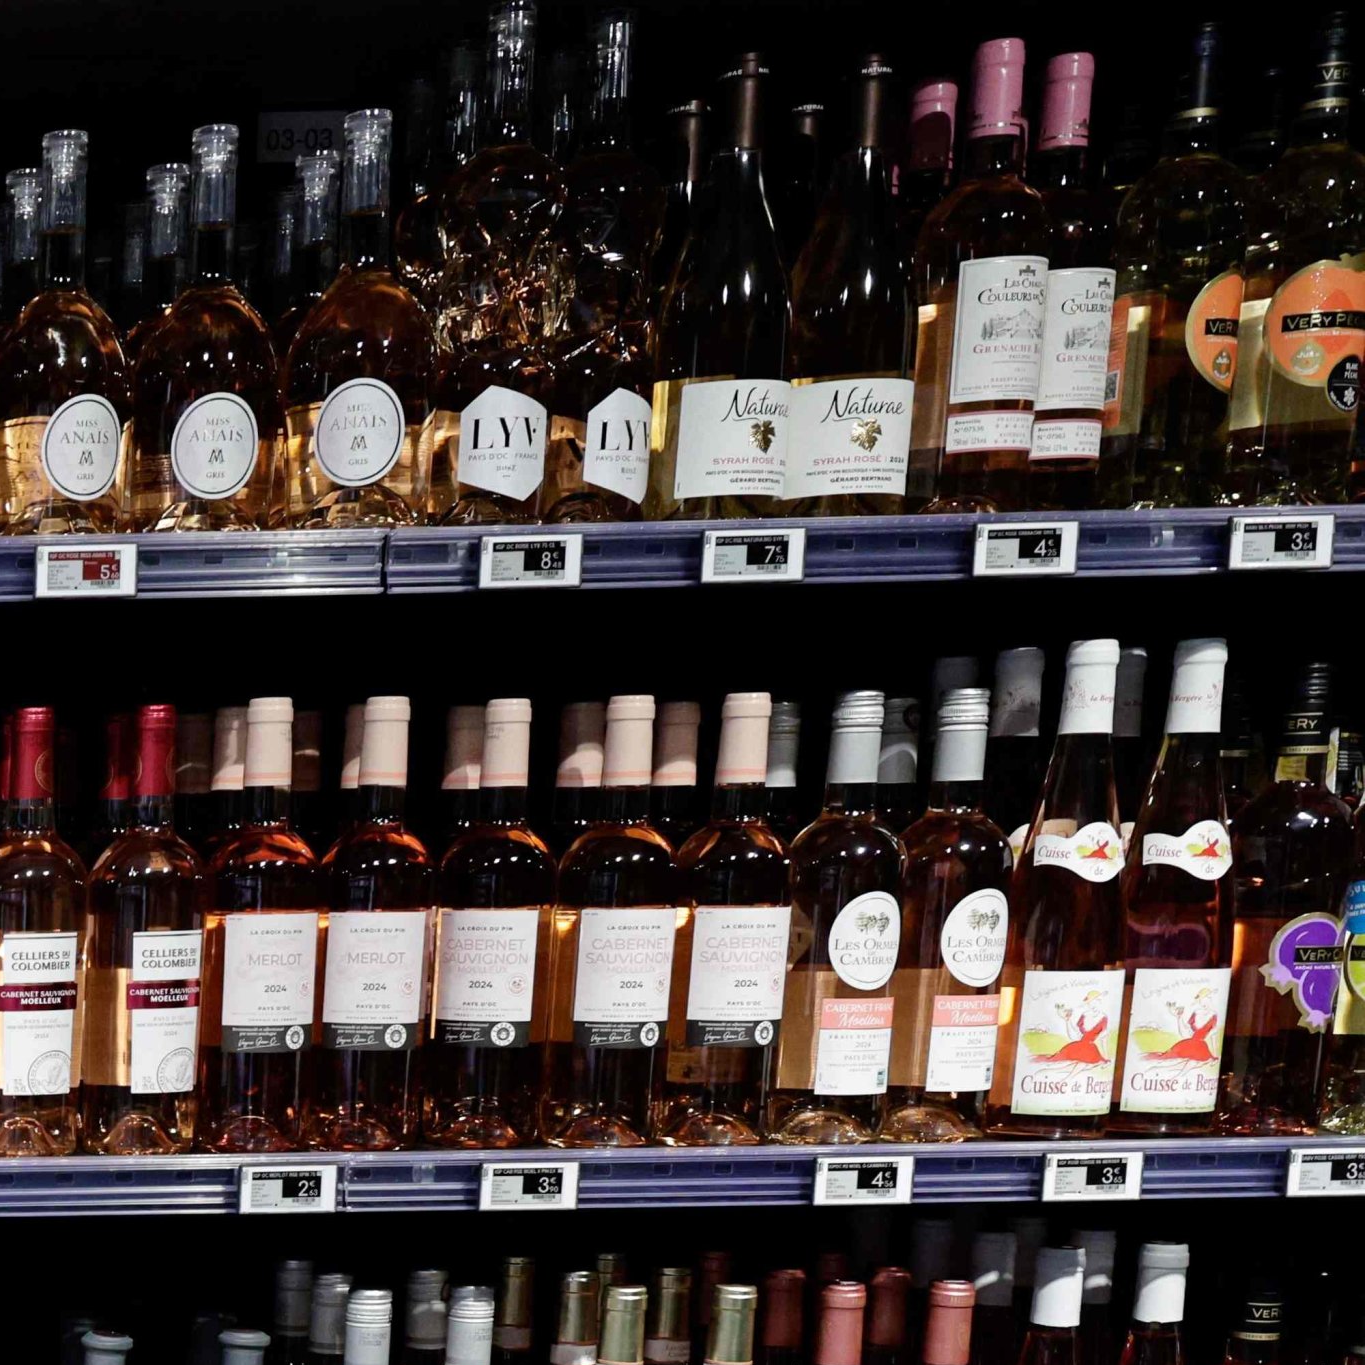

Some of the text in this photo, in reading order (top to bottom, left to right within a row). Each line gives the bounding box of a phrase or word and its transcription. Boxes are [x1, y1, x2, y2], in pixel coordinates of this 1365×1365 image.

[820, 387, 906, 424] Naturae
[813, 455, 882, 466] SYRAH ROSÉ
[1037, 845, 1071, 860] Cuisse
[446, 937, 525, 952] CABERNET
[248, 952, 302, 966] MERLOT
[264, 984, 288, 993] 2024
[1021, 1076, 1082, 1095] Cuisse de
